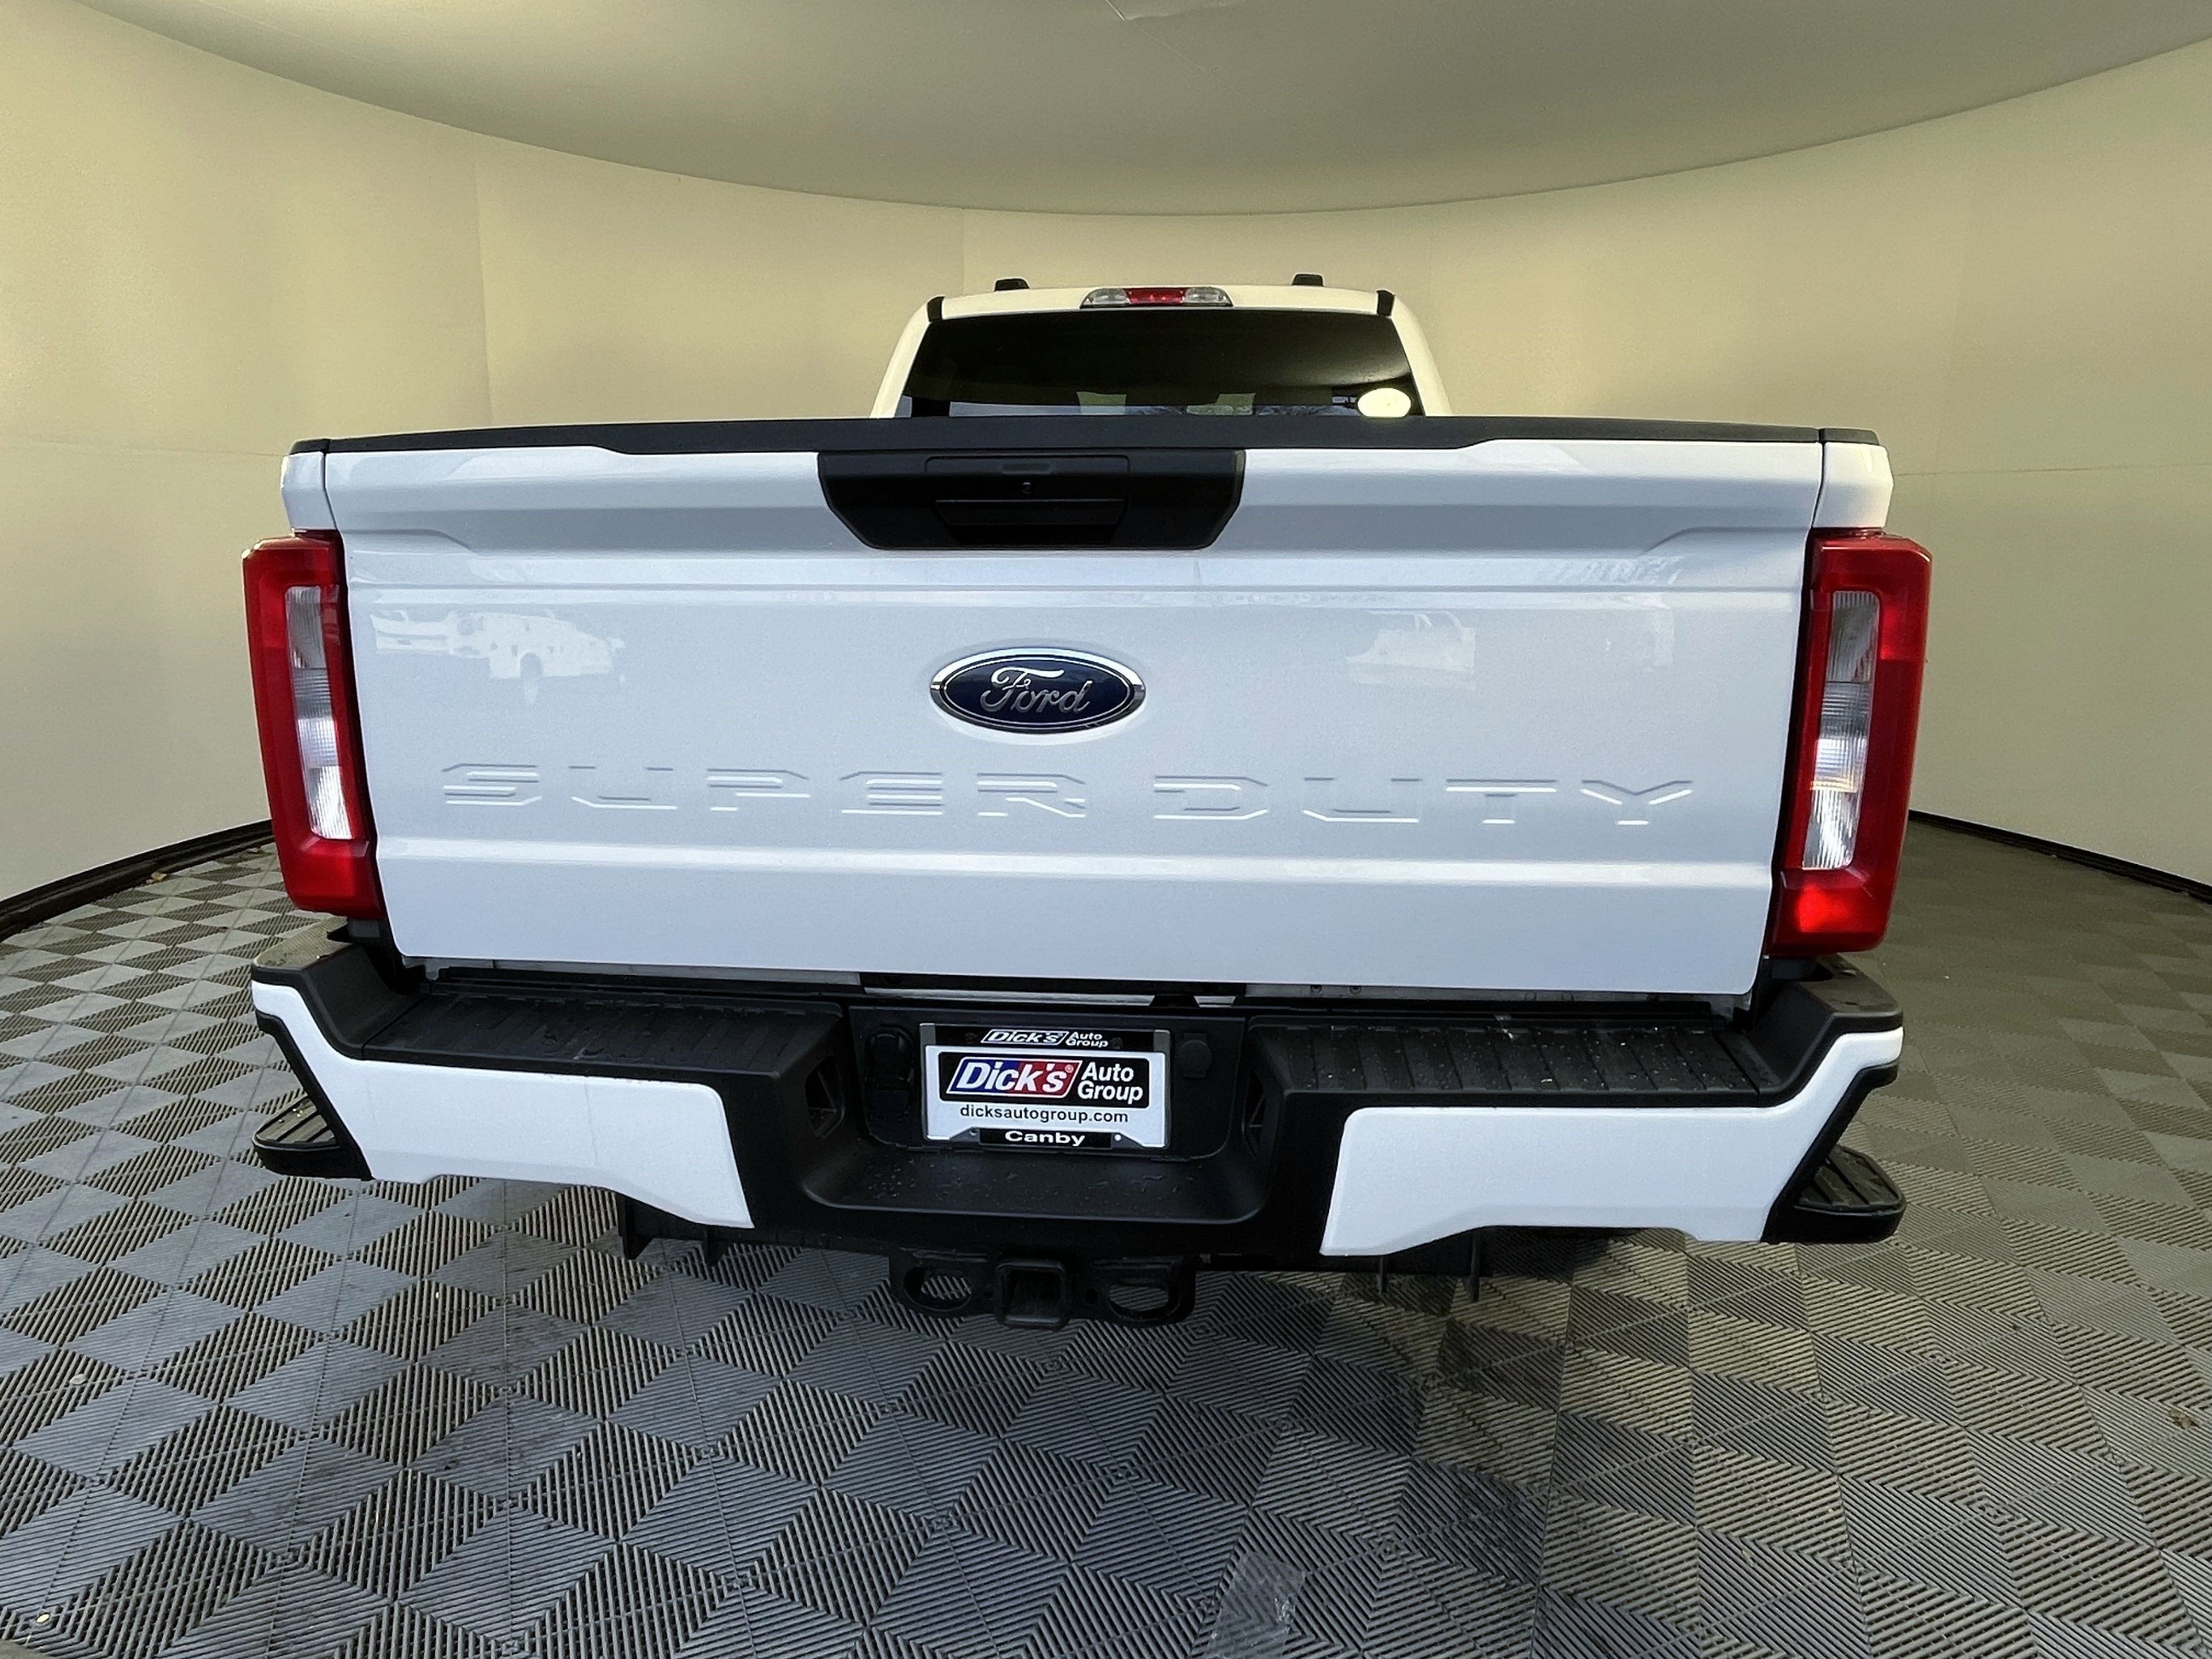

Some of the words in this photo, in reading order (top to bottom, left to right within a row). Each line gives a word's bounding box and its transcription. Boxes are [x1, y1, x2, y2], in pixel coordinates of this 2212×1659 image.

[980, 667, 1092, 713] Ford
[442, 763, 1086, 817] SUPER
[1154, 776, 1692, 825] DUTY
[1065, 1039, 1108, 1048] Group
[1071, 1031, 1103, 1040] Auto
[956, 1061, 1068, 1092] Dick's
[1081, 1062, 1134, 1082] Auto
[1078, 1083, 1143, 1104] Group
[960, 1104, 1128, 1123] dicksautogroup.com
[1005, 1131, 1085, 1146] Canby
